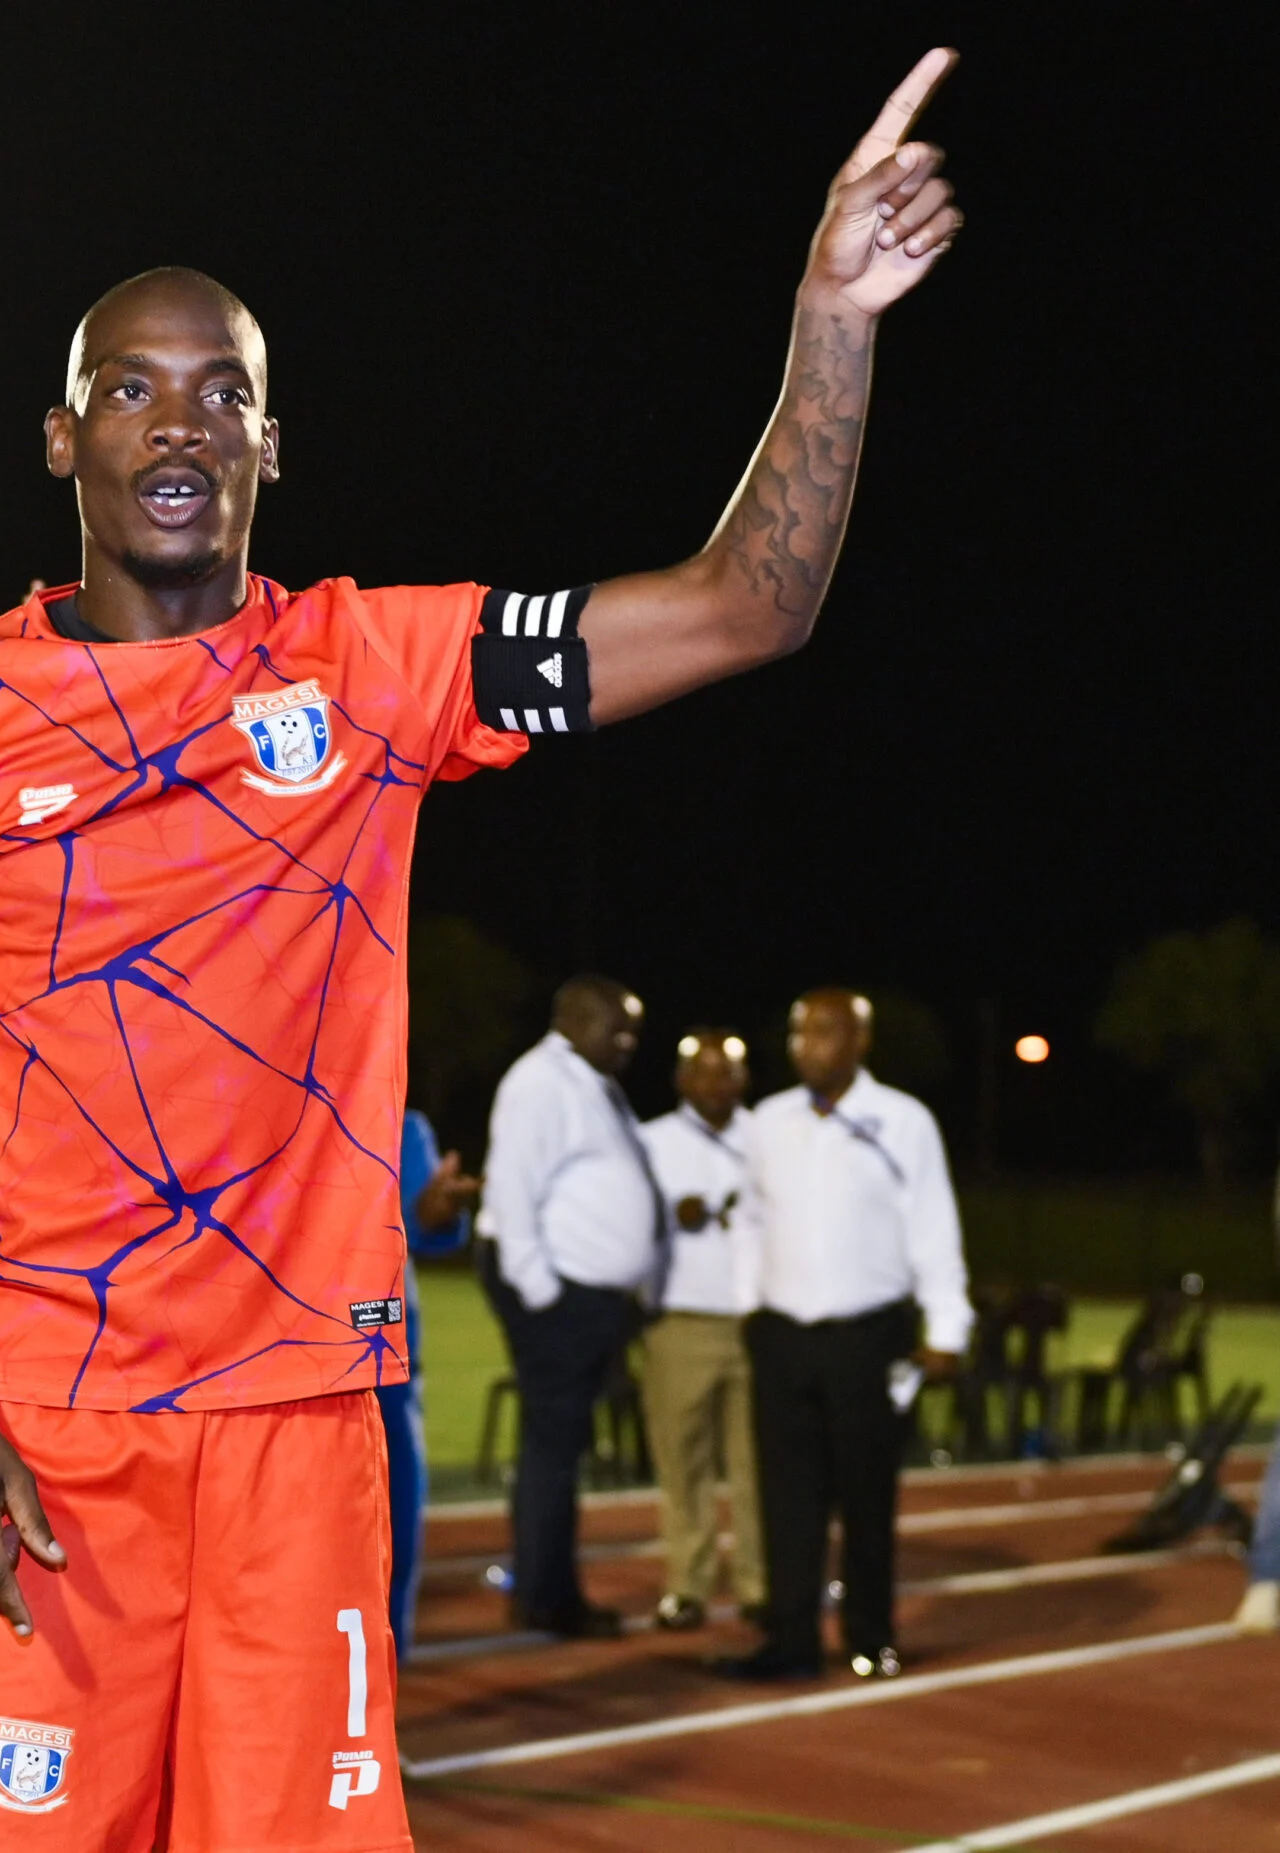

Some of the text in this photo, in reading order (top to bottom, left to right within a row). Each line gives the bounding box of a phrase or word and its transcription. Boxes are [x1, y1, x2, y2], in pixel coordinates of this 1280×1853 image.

[233, 686, 322, 718] MAGESI
[257, 723, 326, 750] F C
[350, 1300, 385, 1311] MAGESI
[336, 1608, 368, 1738] 1
[0, 1724, 71, 1747] MAGESI
[1, 1757, 60, 1777] F C
